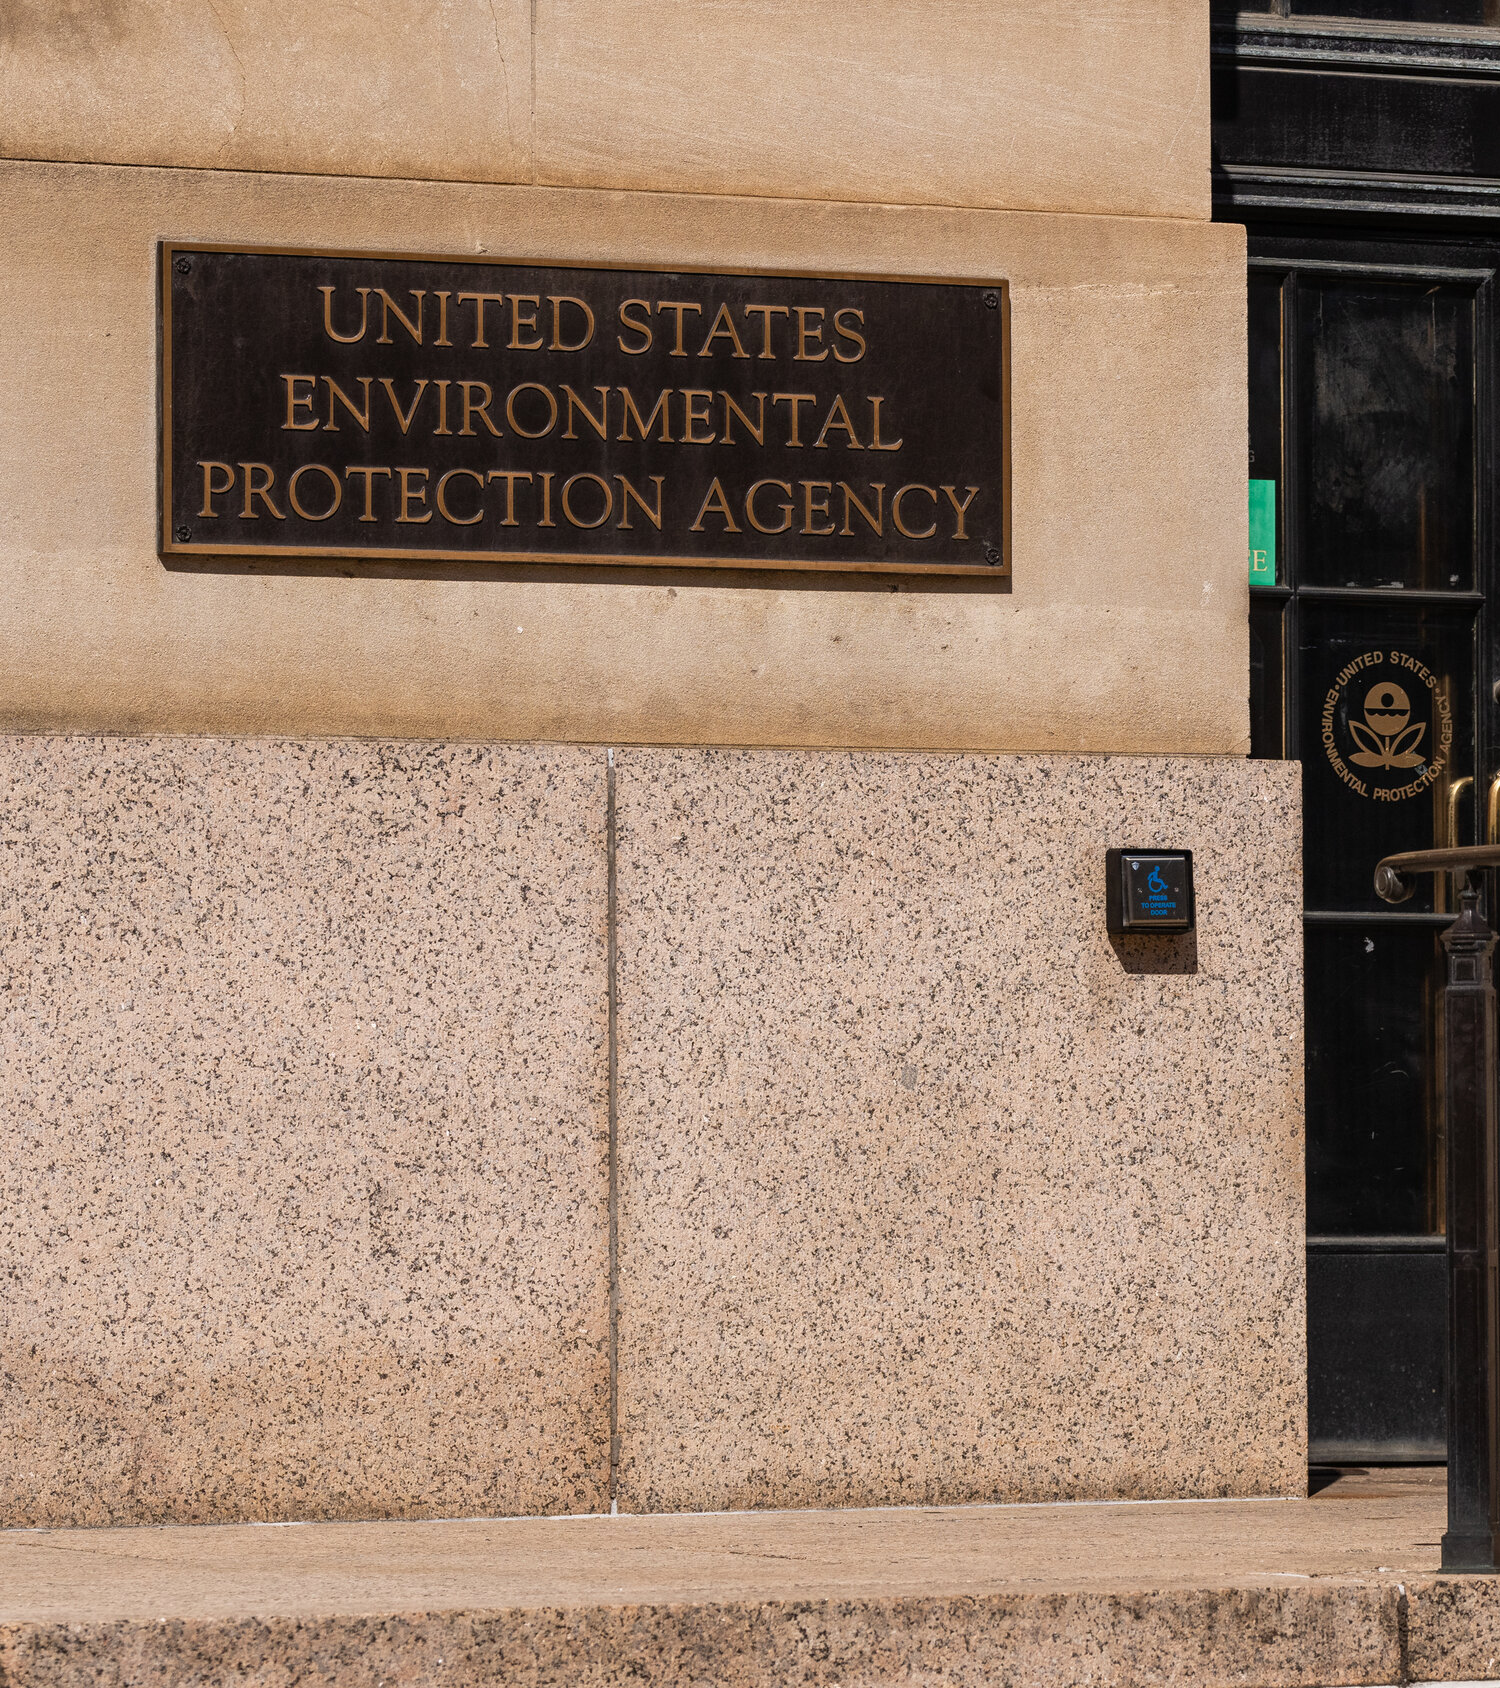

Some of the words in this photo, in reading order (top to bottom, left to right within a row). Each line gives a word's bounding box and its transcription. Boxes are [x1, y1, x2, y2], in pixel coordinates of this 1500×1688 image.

[317, 286, 596, 353] UNITED
[617, 299, 868, 364] STATES
[280, 373, 904, 451] ENVIRONMENTAL
[195, 461, 664, 532] PROTECTION
[689, 476, 981, 541] AGENCY
[1336, 651, 1383, 686] UNITED
[1390, 651, 1436, 688] STATES
[1322, 689, 1368, 797] ENVIRONMENTAL
[1373, 755, 1446, 802] PROTECTION
[1436, 696, 1453, 755] AGENCY
